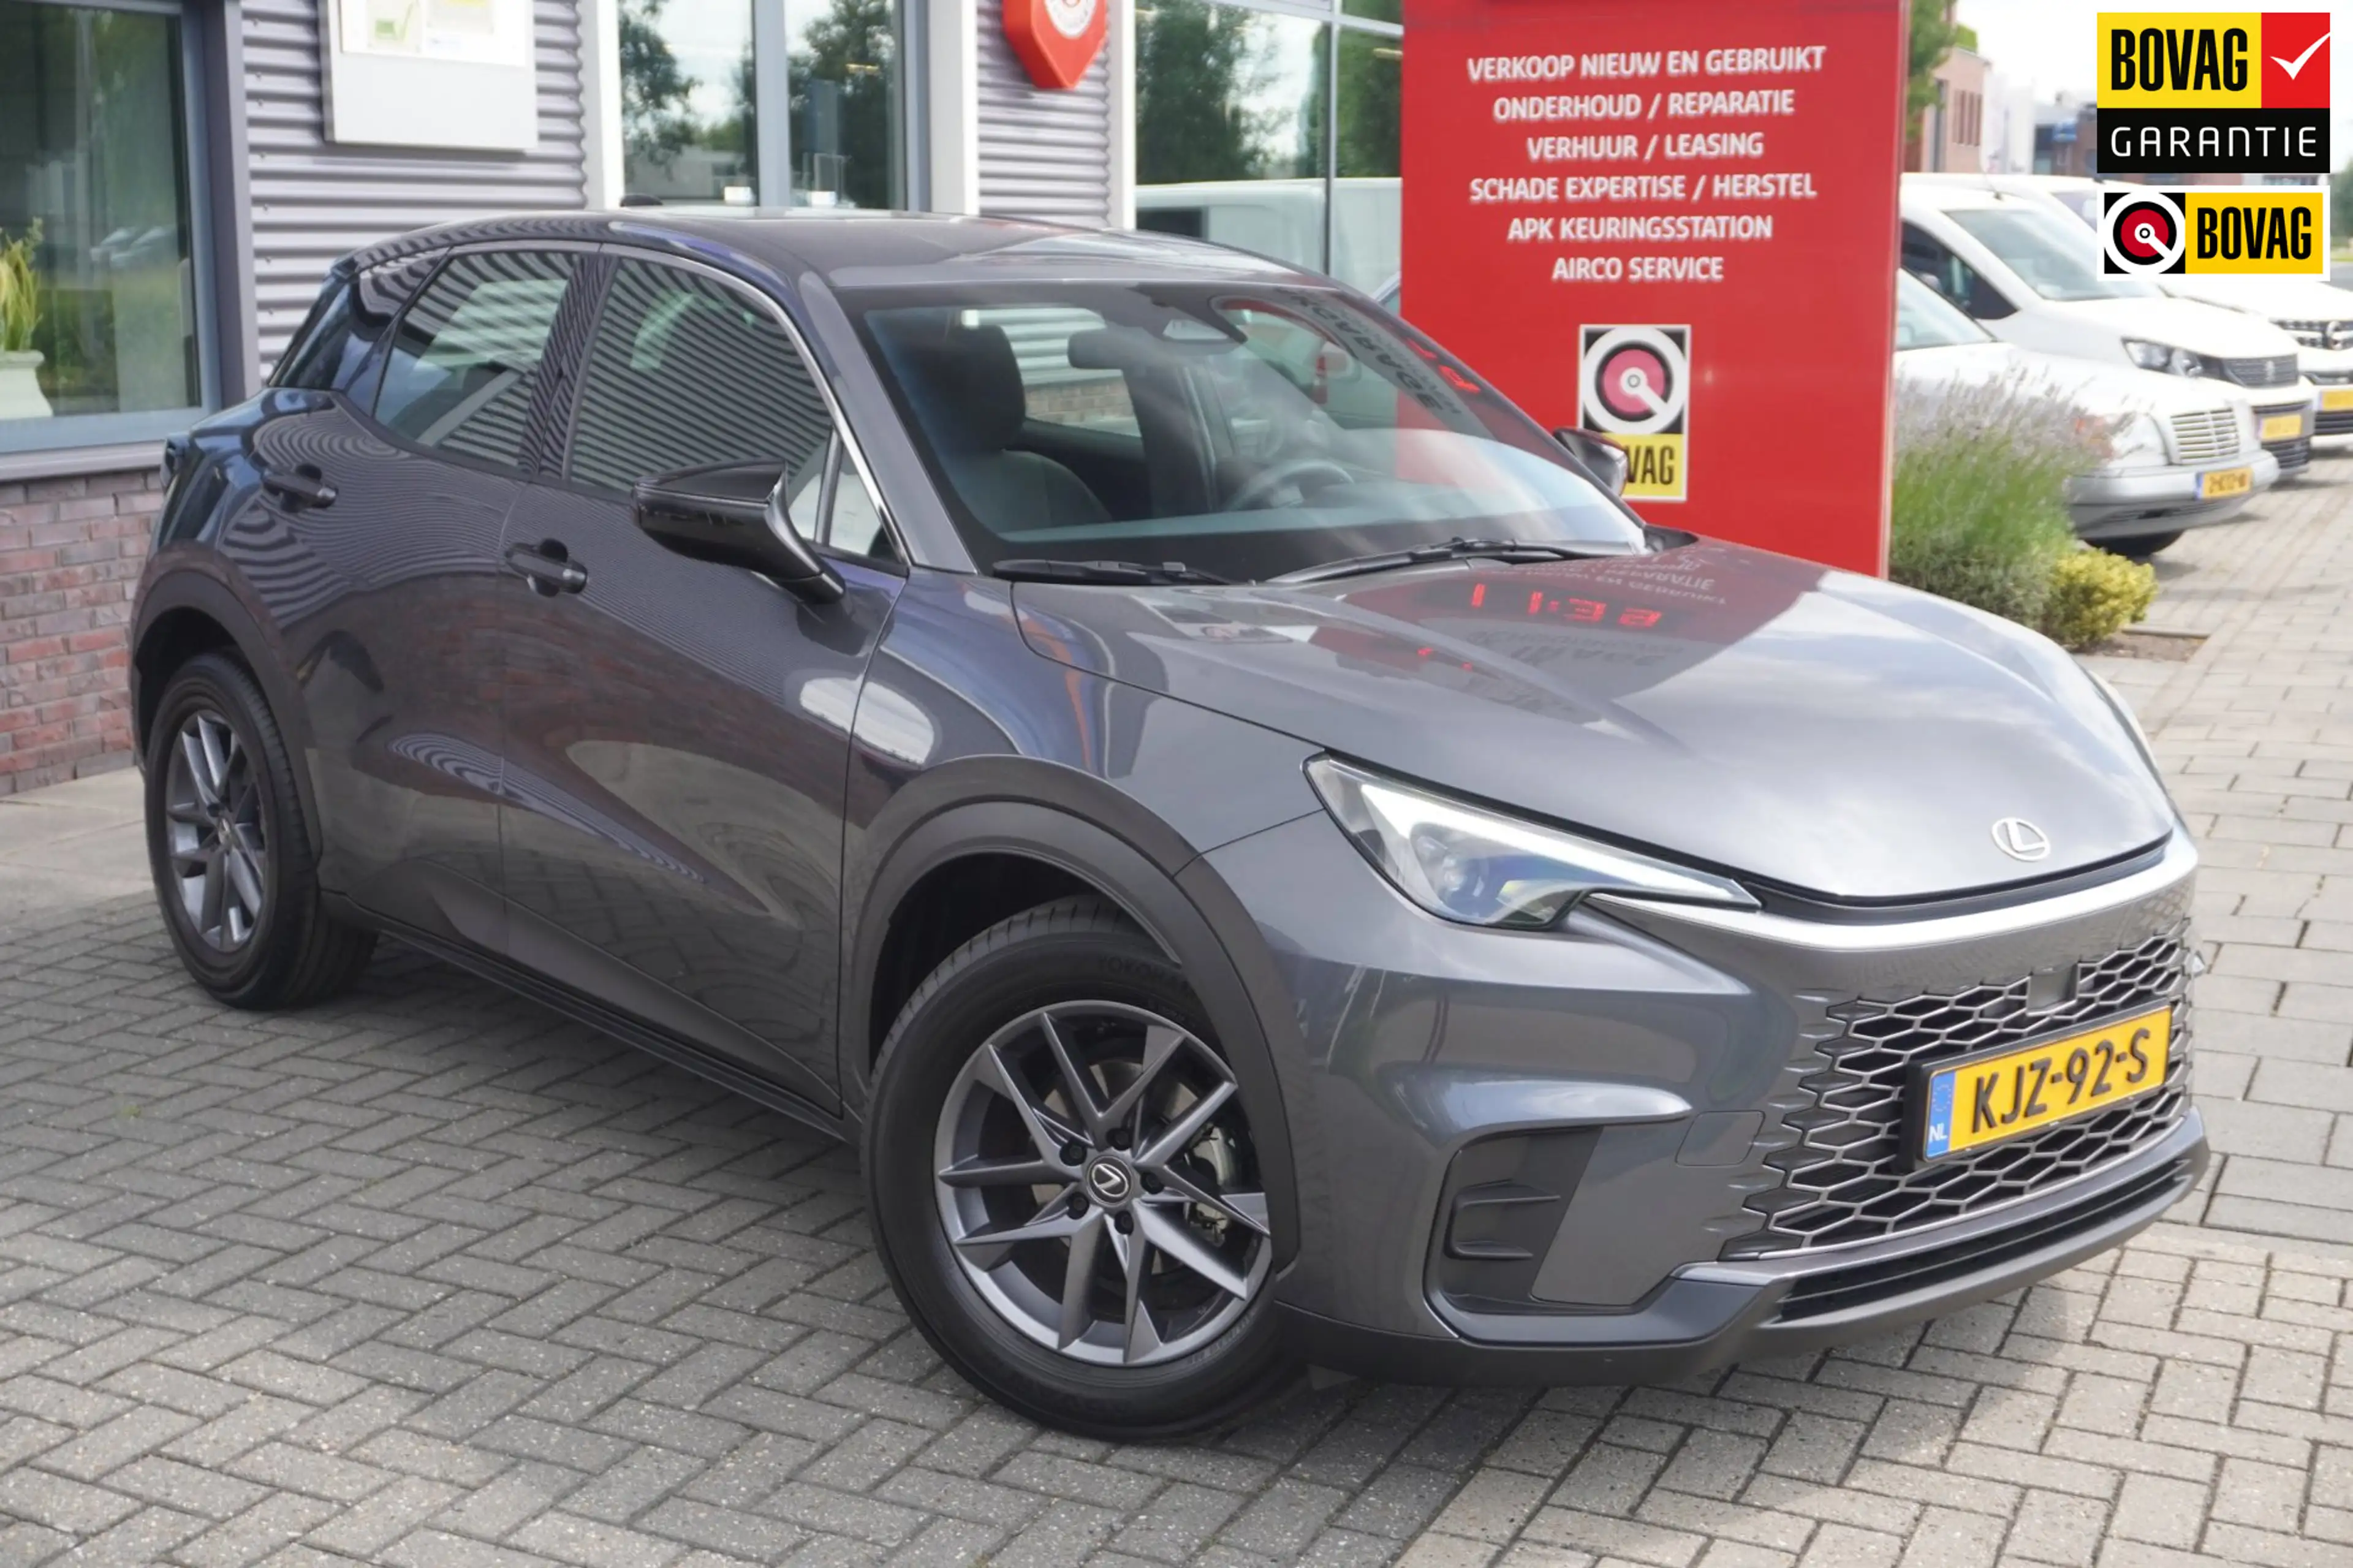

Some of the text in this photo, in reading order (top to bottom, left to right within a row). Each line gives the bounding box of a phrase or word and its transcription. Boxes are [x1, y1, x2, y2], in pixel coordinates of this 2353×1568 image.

[1468, 46, 1826, 81] VERKOOP NIEUW EN GEBRUIKT
[1494, 89, 1795, 121] ONDERHOUD / REPARATIE
[1528, 132, 1764, 161] VERHUUR / LEASING
[1471, 173, 1817, 202] SCHADE EXPERTISE / HERSTEL
[1508, 215, 1772, 241] APK KEURINGSSTATION
[1552, 256, 1724, 281] AIRCO SERVICE
[1625, 445, 1674, 485] VAG
[1972, 1028, 2150, 1134] KJZ-92-S
[1929, 1123, 1948, 1143] NL
